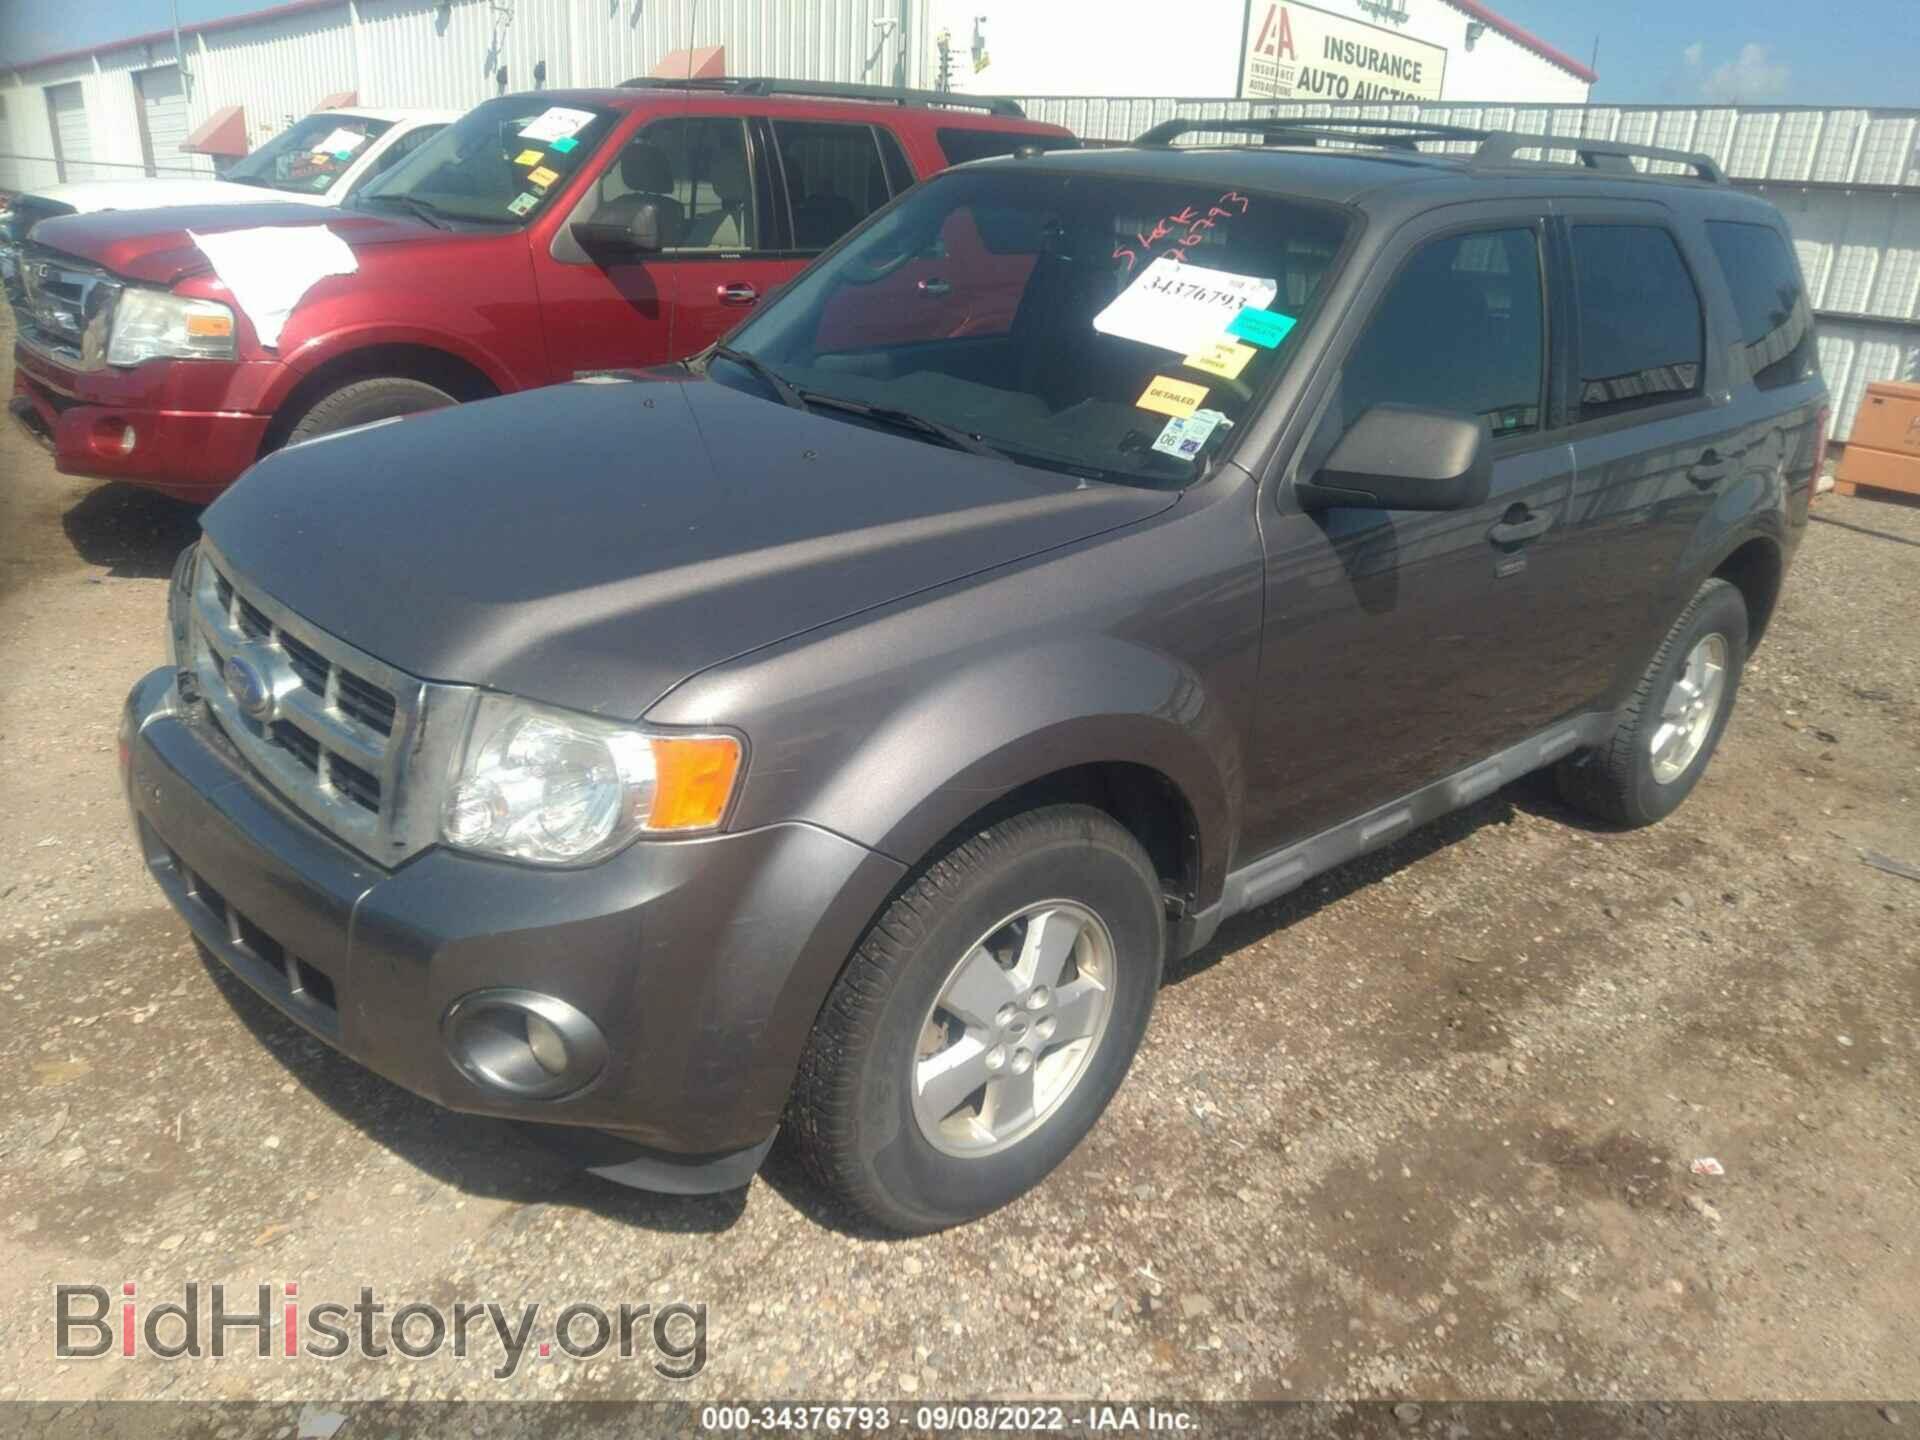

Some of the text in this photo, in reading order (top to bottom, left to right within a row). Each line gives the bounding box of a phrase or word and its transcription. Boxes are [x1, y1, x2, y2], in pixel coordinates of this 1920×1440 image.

[1323, 35, 1423, 84] INSURANCE
[1297, 66, 1349, 99] AUTO
[1143, 275, 1248, 310] 34376793
[1150, 388, 1196, 407] DETAILED
[1159, 433, 1178, 447] 06
